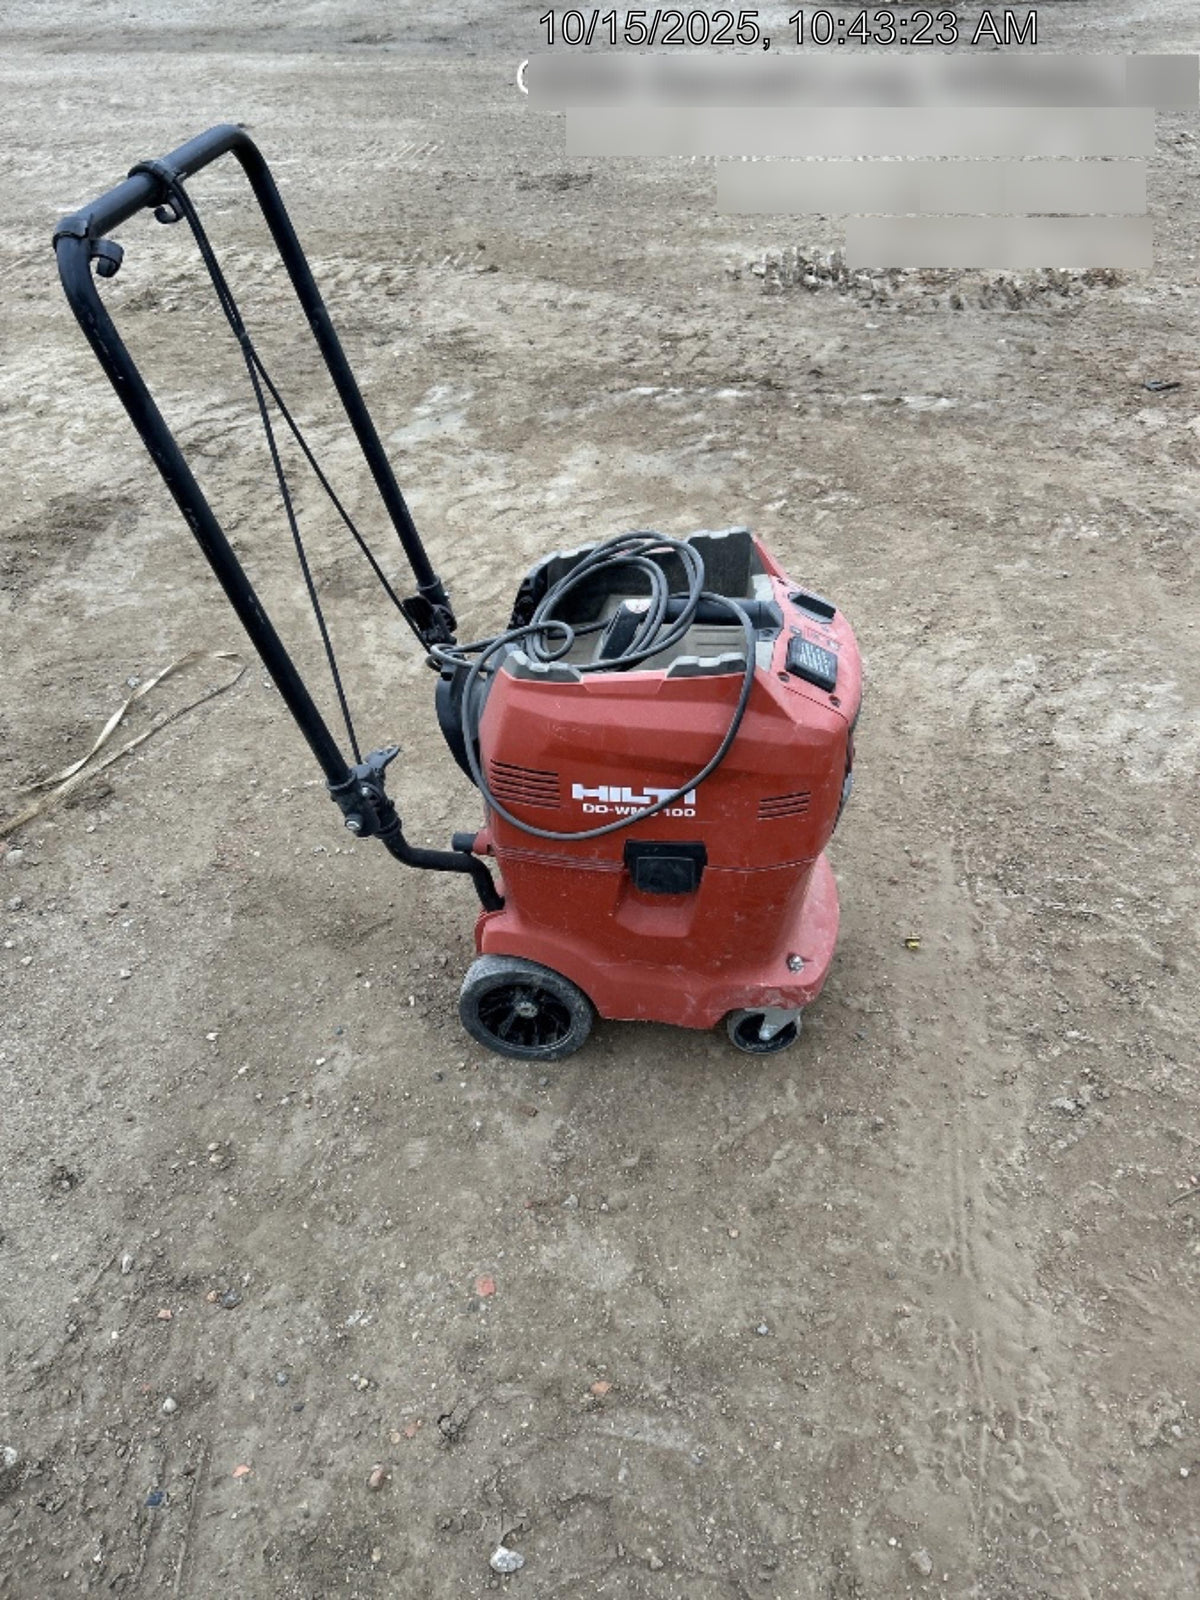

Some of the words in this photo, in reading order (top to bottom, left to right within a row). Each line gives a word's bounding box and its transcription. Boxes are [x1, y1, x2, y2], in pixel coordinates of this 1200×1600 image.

[572, 783, 696, 805] HILTI
[583, 803, 659, 817] DD-WM
[664, 808, 696, 817] 100
